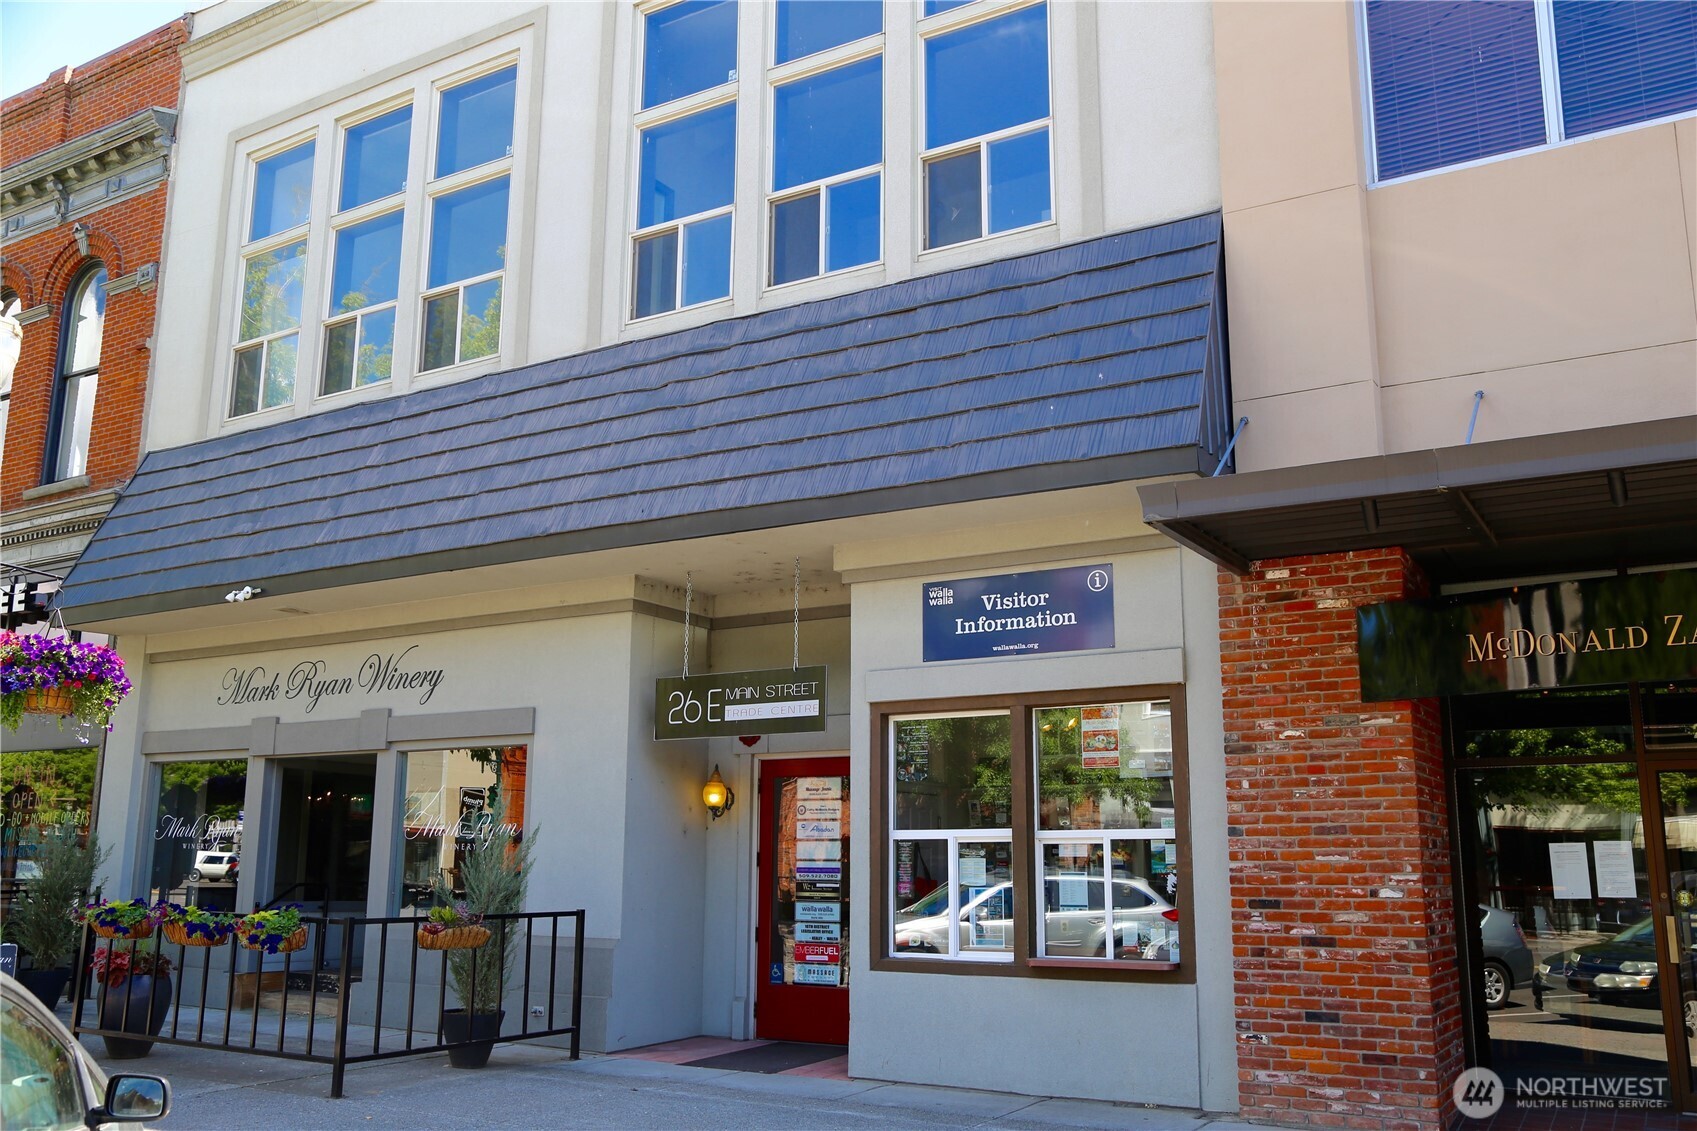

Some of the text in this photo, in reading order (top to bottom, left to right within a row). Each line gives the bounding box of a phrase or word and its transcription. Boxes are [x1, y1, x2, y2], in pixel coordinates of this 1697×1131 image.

[928, 588, 954, 598] walla
[928, 596, 954, 606] walla
[981, 592, 1049, 610] Visitor
[955, 610, 1077, 634] Information
[992, 642, 1039, 652] wallawalla.org
[217, 644, 444, 713] Mark Ryan Winery
[668, 682, 818, 724] 26 E MAIN STREET
[726, 704, 818, 718] TRADE CENTRE
[12, 792, 42, 809] OPEN
[154, 814, 242, 851] Mark Ryan
[404, 809, 474, 840] Mark
[466, 810, 522, 852] Ryan
